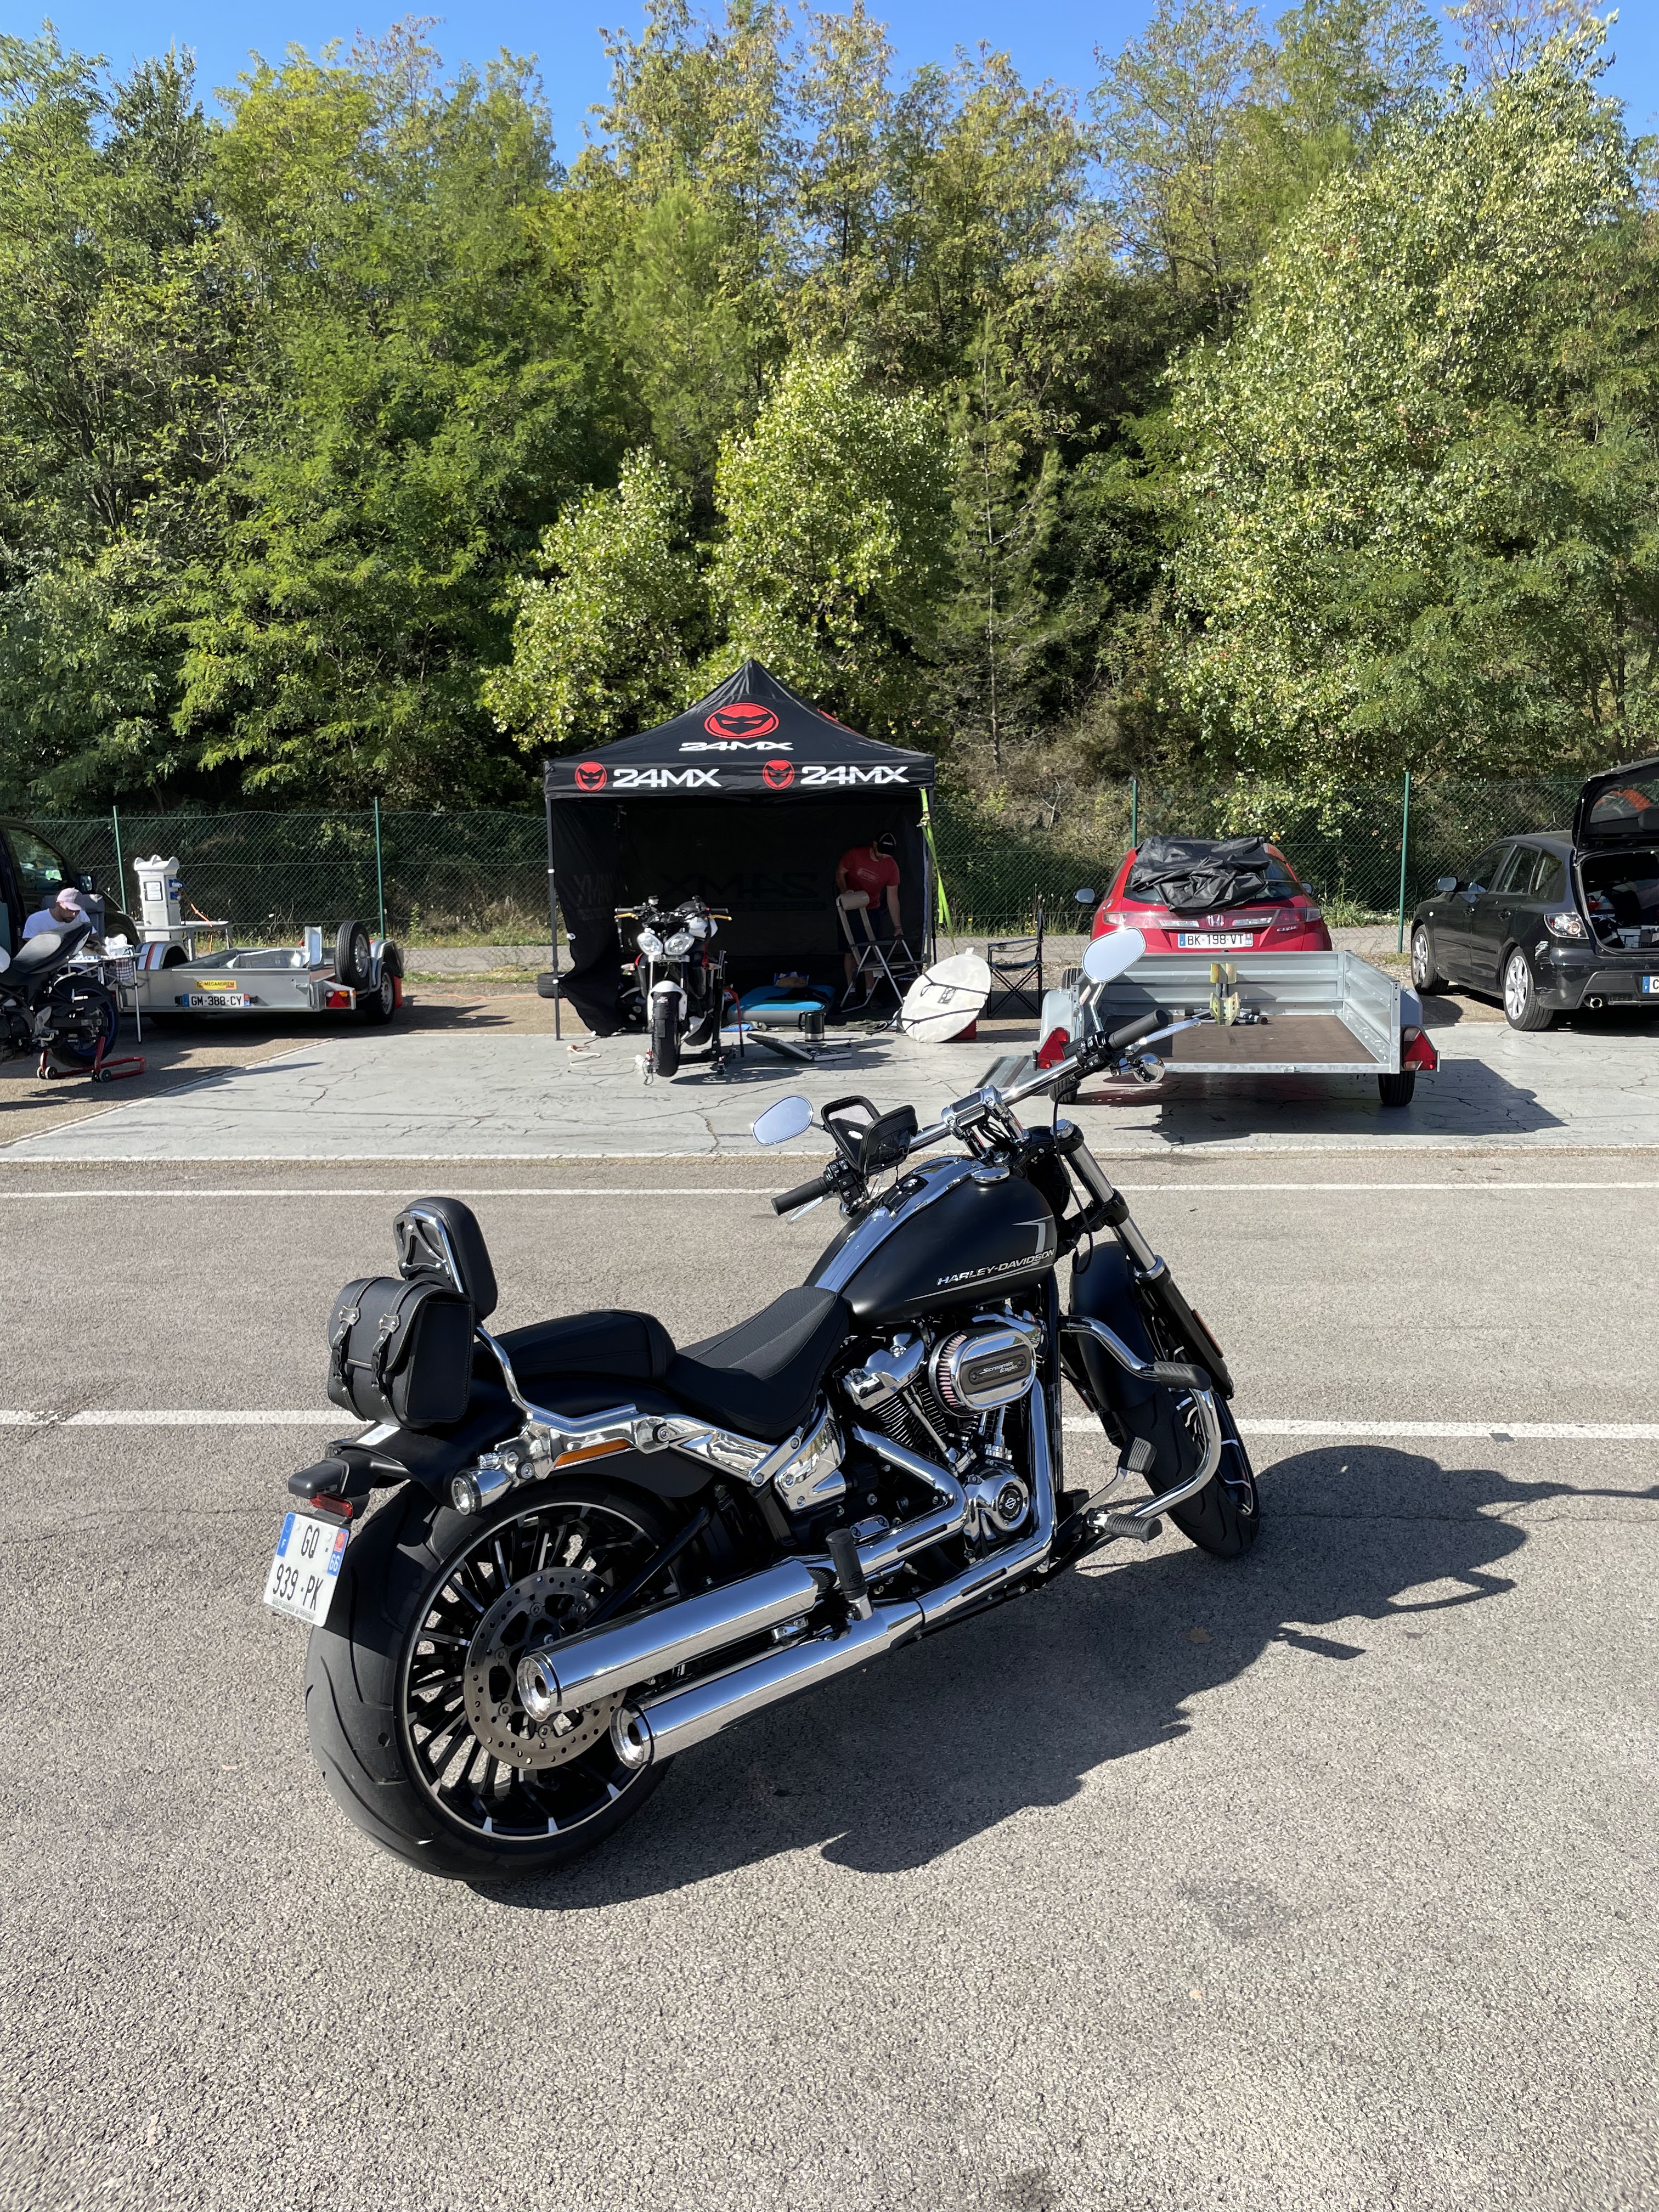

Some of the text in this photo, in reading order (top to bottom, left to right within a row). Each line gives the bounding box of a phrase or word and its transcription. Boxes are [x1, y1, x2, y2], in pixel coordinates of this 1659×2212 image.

[679, 741, 794, 751] 24MX
[612, 769, 722, 788] 24MX
[800, 766, 910, 785] 24MX
[191, 996, 242, 1006] GM-388-CY
[936, 1248, 1054, 1286] HARLEY-DAVIDSON
[329, 1553, 340, 1572] 66
